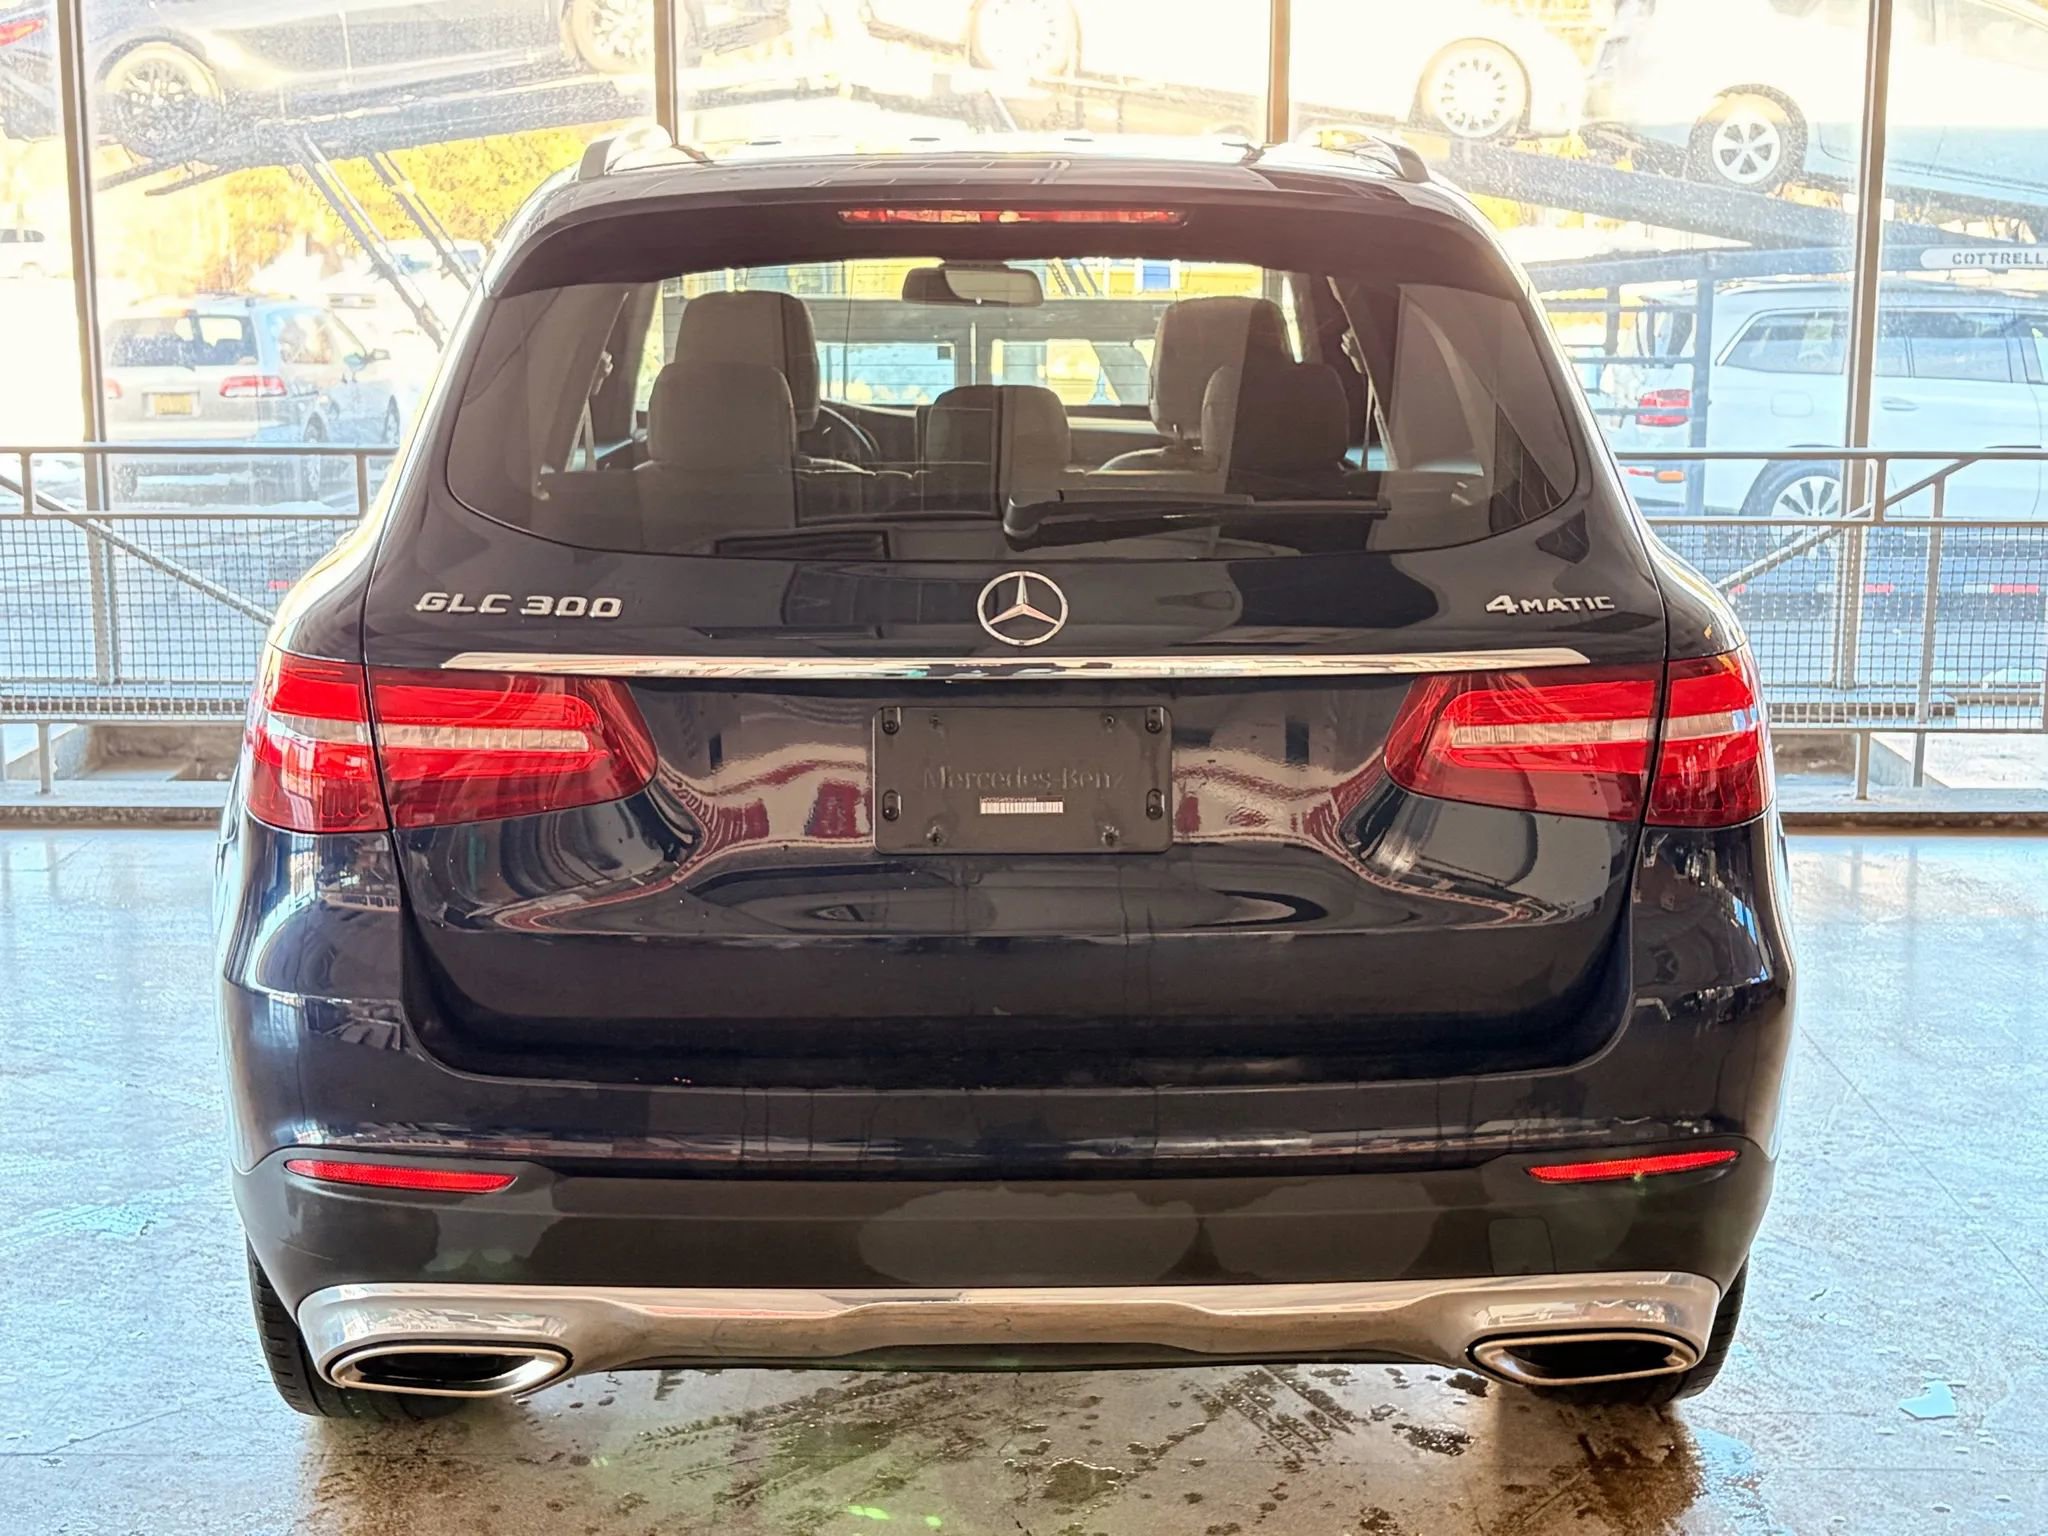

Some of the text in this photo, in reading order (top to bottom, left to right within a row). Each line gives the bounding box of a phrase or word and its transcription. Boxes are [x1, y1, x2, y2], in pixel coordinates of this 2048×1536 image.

[1952, 252, 2044, 265] COTTRELL
[415, 592, 624, 618] GLC 300
[1486, 595, 1616, 615] 4MATIC
